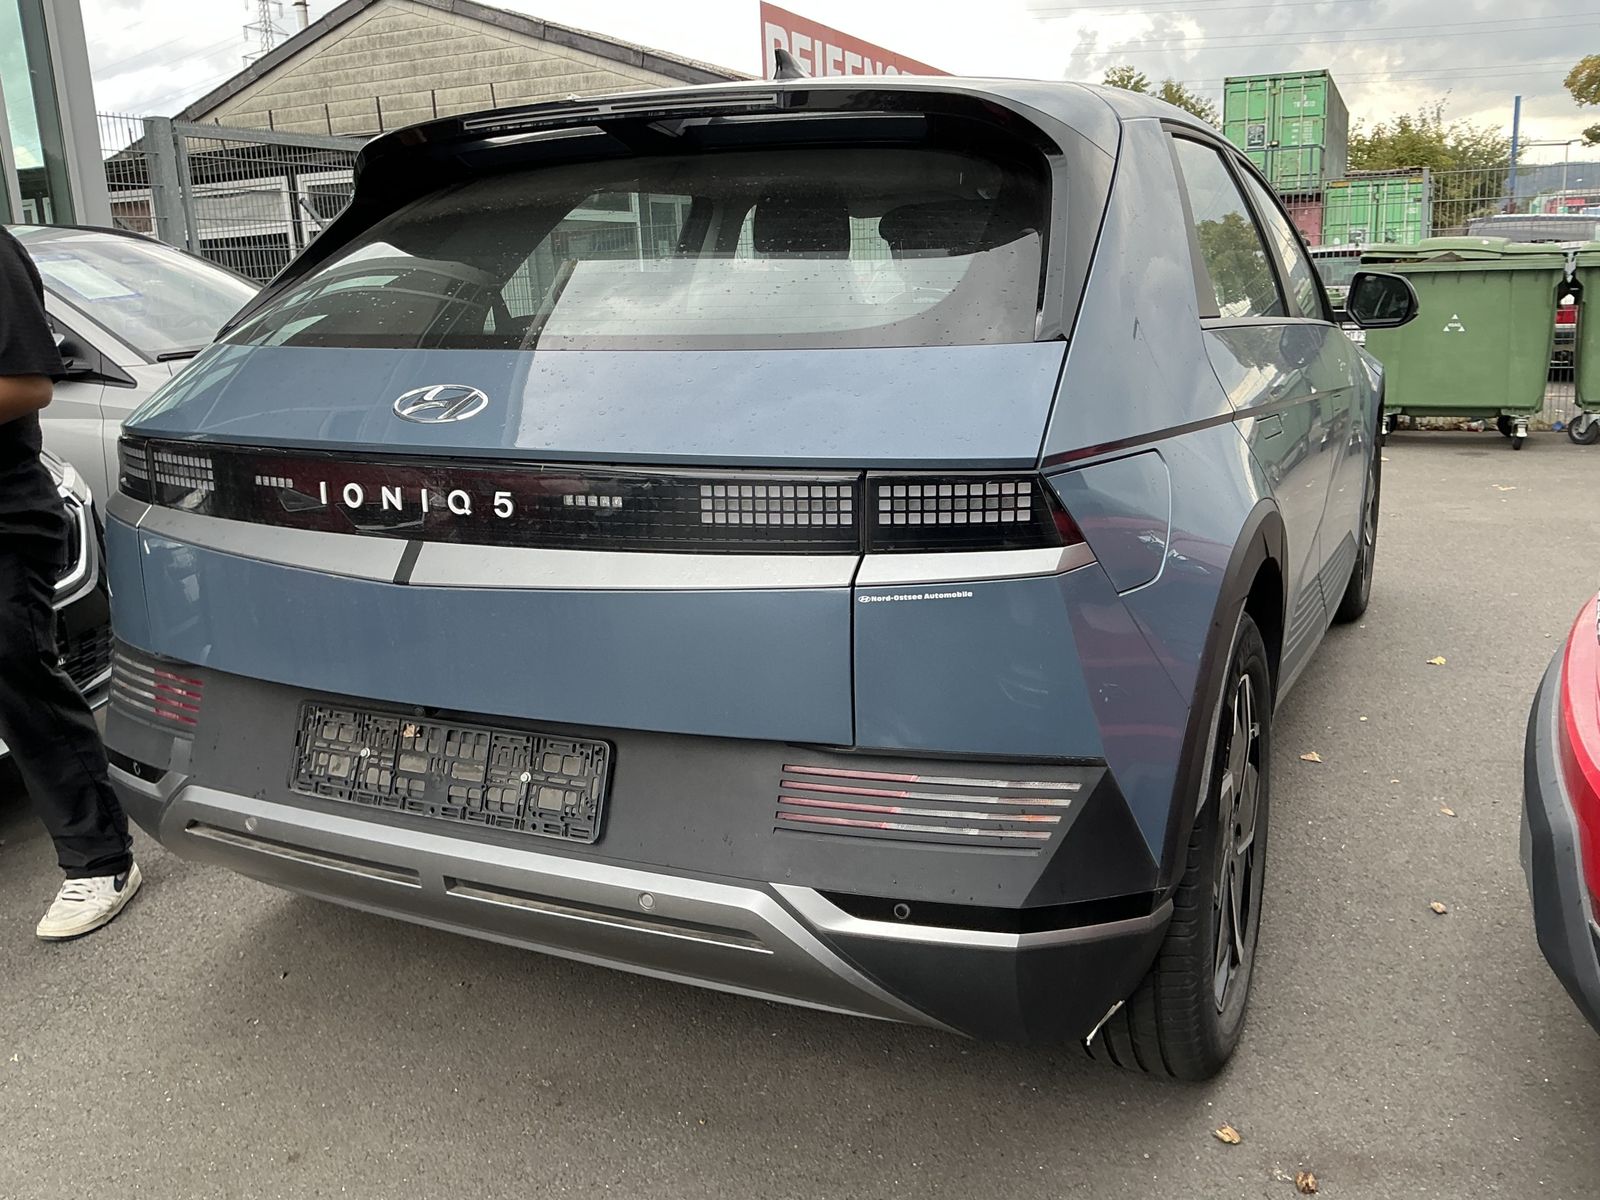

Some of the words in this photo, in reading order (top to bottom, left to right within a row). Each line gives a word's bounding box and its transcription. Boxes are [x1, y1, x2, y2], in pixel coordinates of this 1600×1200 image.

[319, 481, 472, 516] IONIQ
[493, 491, 514, 518] 5
[871, 594, 923, 602] Nord-Ostsee
[924, 590, 973, 600] Automobile
